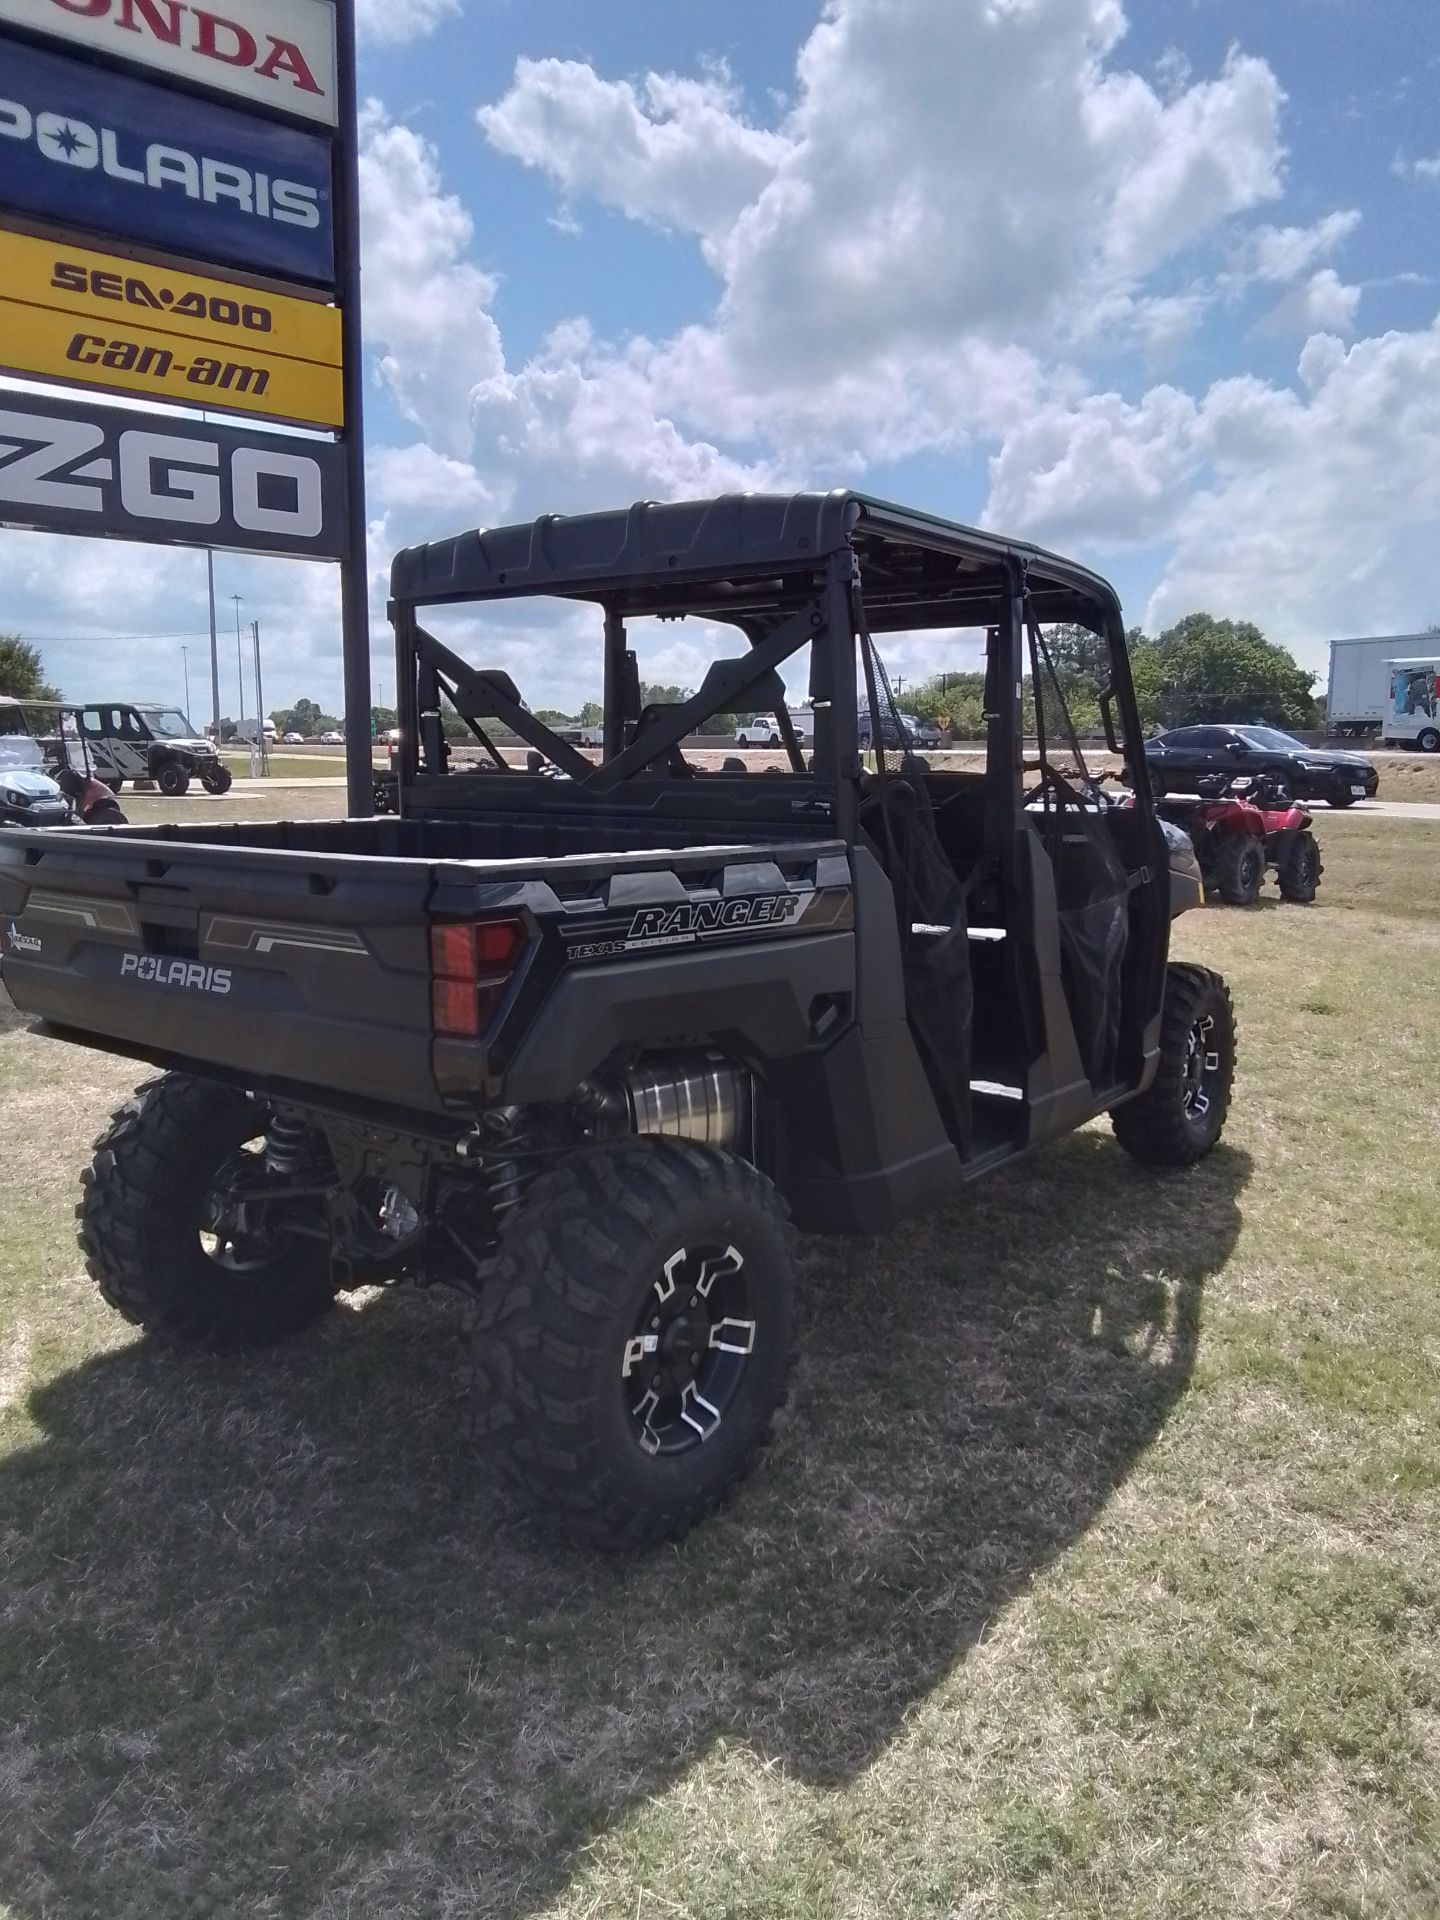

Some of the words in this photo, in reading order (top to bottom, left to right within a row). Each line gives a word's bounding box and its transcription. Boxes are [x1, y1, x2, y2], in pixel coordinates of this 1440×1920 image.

[627, 895, 800, 938] RANGER
[567, 940, 627, 959] TEXAS
[120, 953, 233, 994] POLARIS
